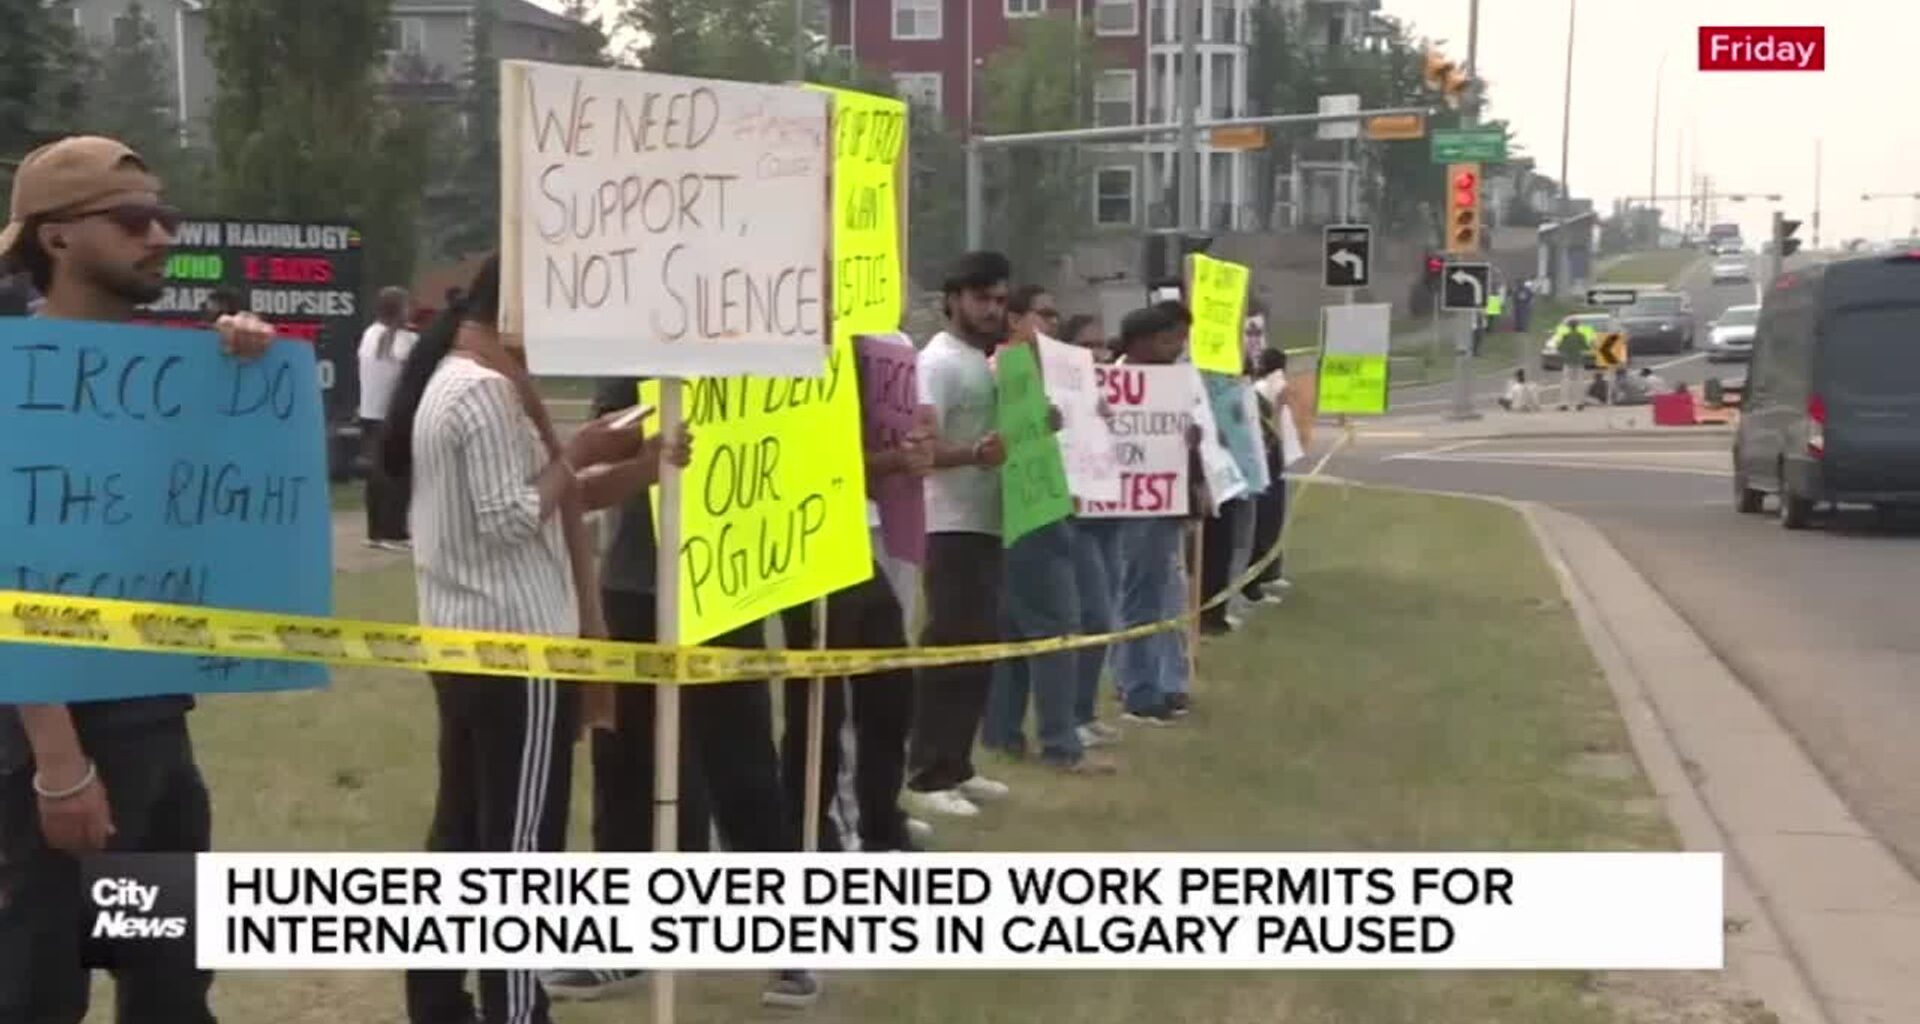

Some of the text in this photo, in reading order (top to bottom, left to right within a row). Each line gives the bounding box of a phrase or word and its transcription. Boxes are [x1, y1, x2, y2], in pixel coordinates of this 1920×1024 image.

[527, 76, 596, 156] WE
[613, 87, 719, 153] NEED
[173, 221, 351, 250] WN RADIOLOGY
[538, 163, 748, 244] SUPPORT,
[250, 289, 356, 315] BIOPSIES
[545, 243, 818, 341] NOT SILENCE
[13, 344, 297, 421] IRCC DO
[13, 457, 309, 528] THE RIGHT
[703, 436, 781, 516] OUR
